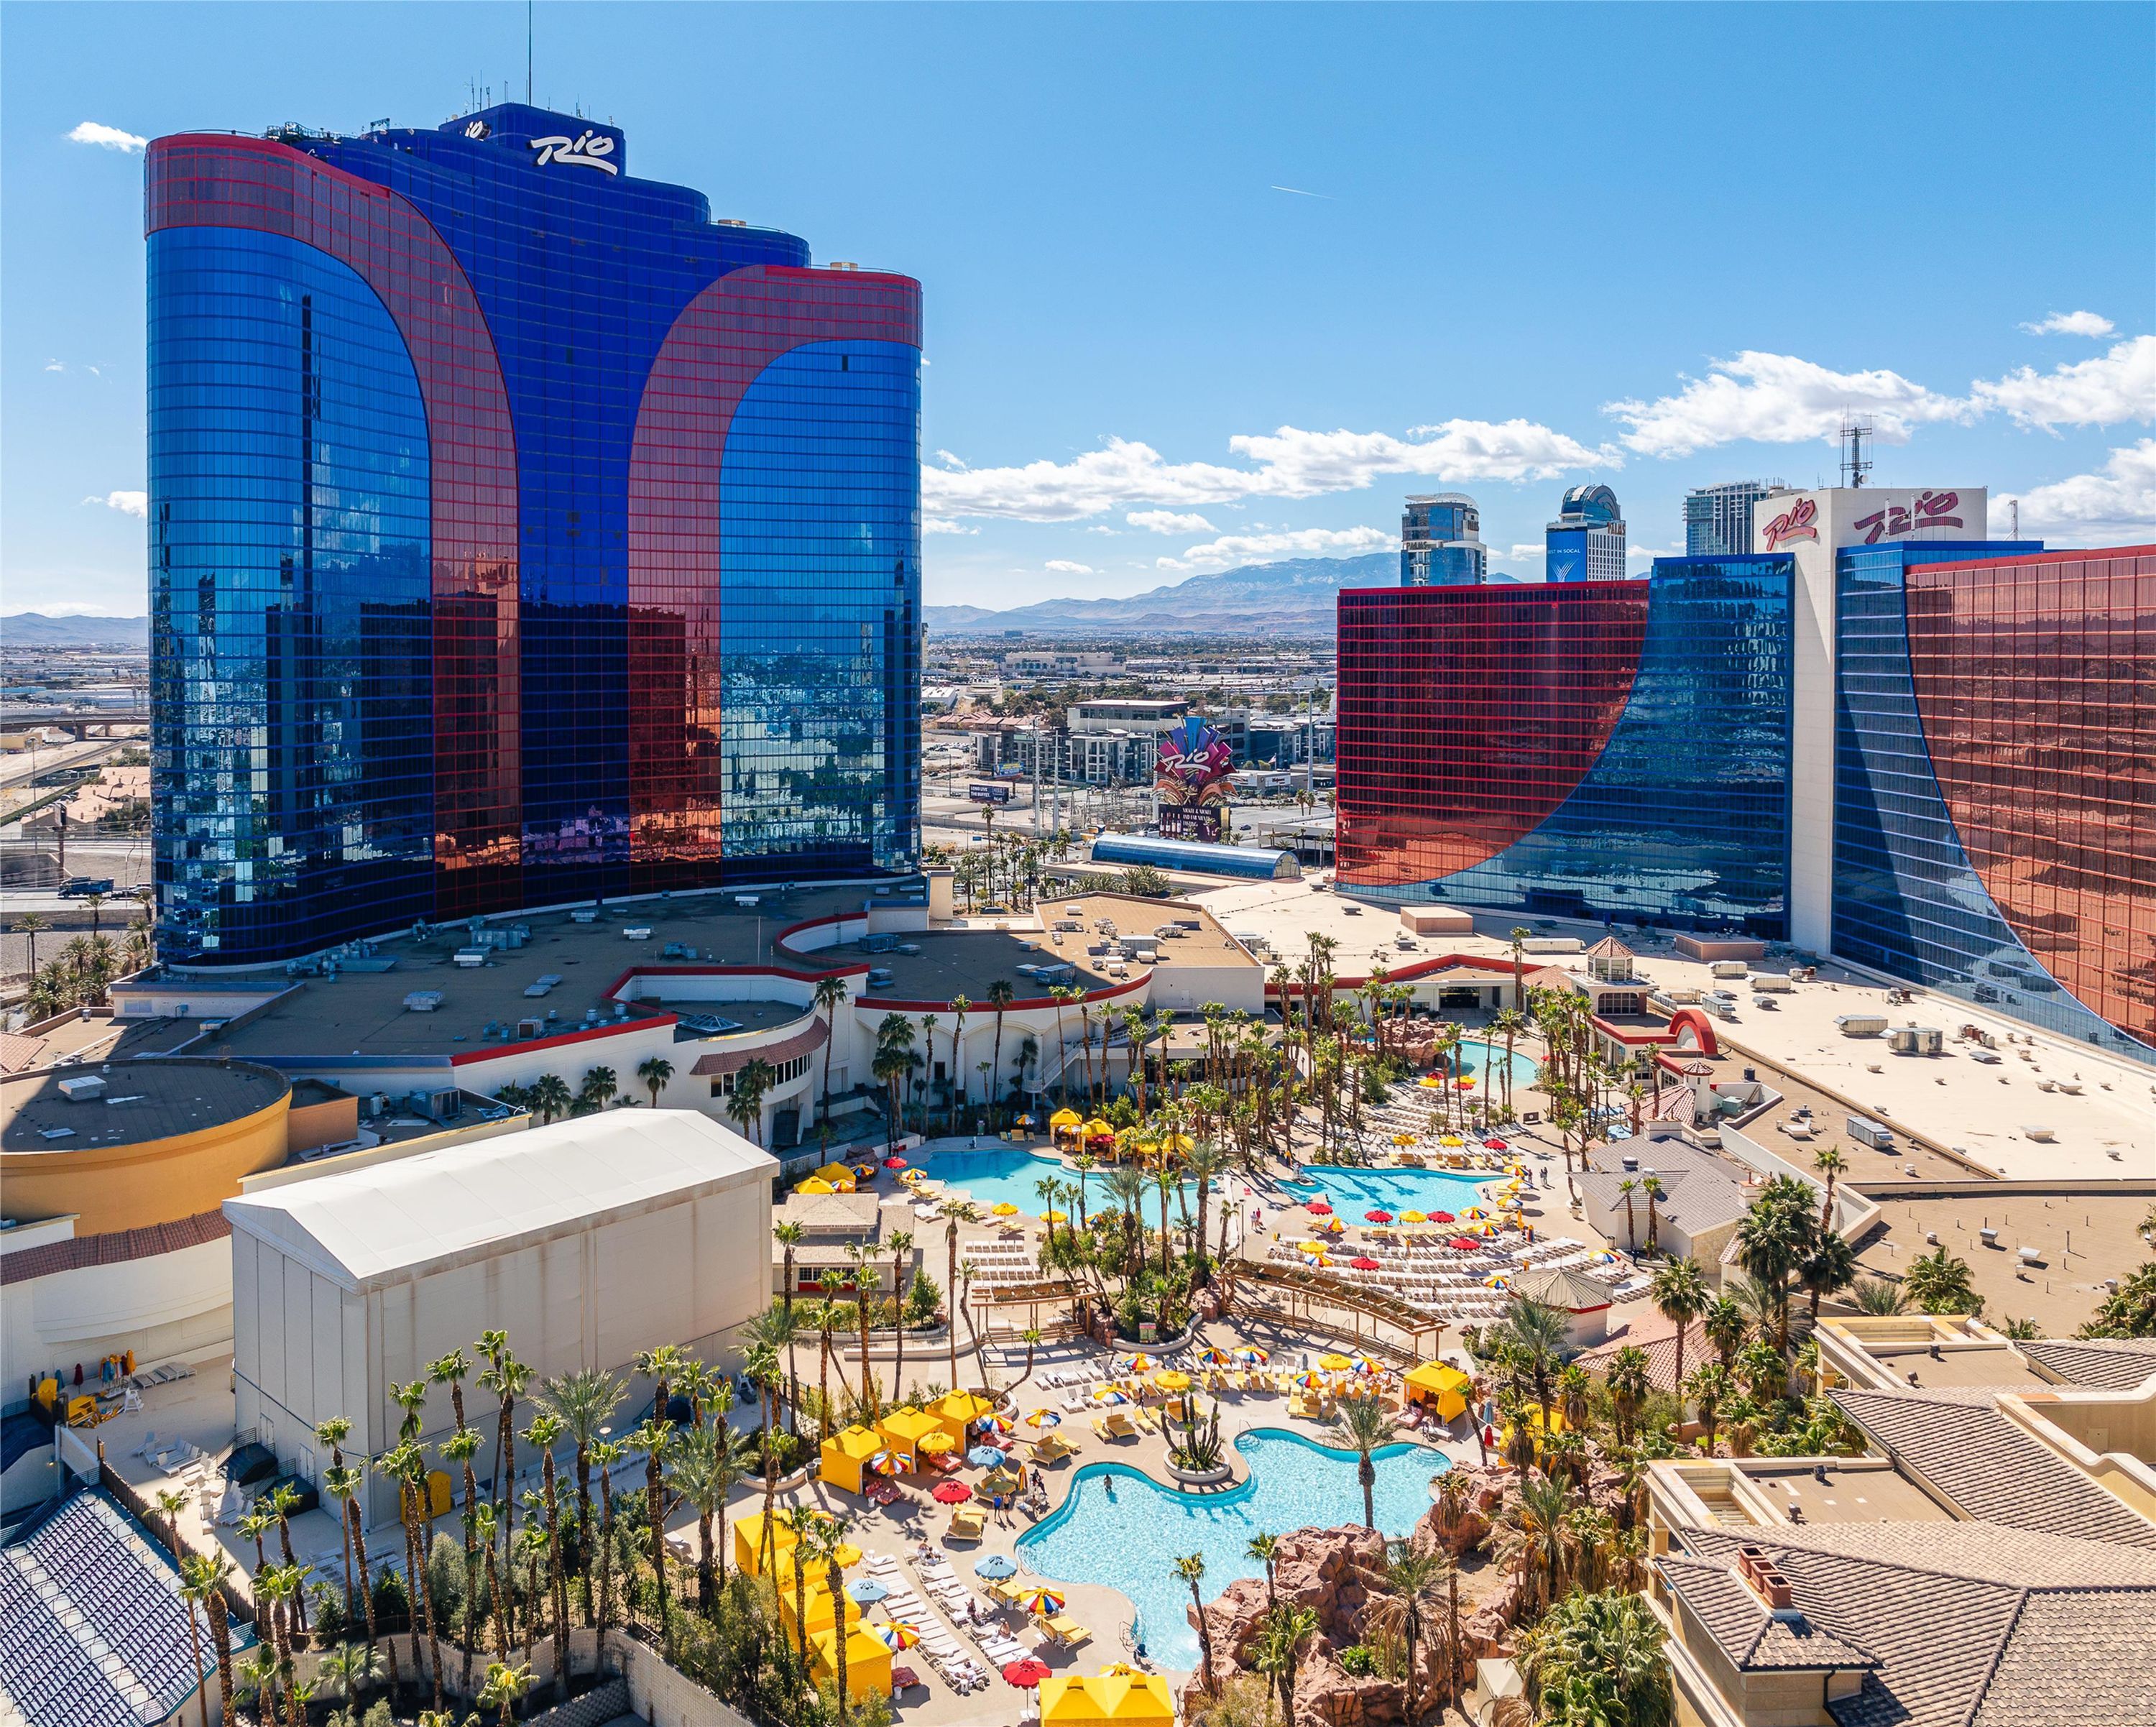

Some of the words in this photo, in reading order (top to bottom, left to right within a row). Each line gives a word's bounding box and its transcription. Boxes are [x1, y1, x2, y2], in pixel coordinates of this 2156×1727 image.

[530, 129, 617, 175] Rio
[1763, 497, 1817, 551] Rio
[1854, 491, 1963, 545] Rio
[1163, 748, 1212, 773] Rio
